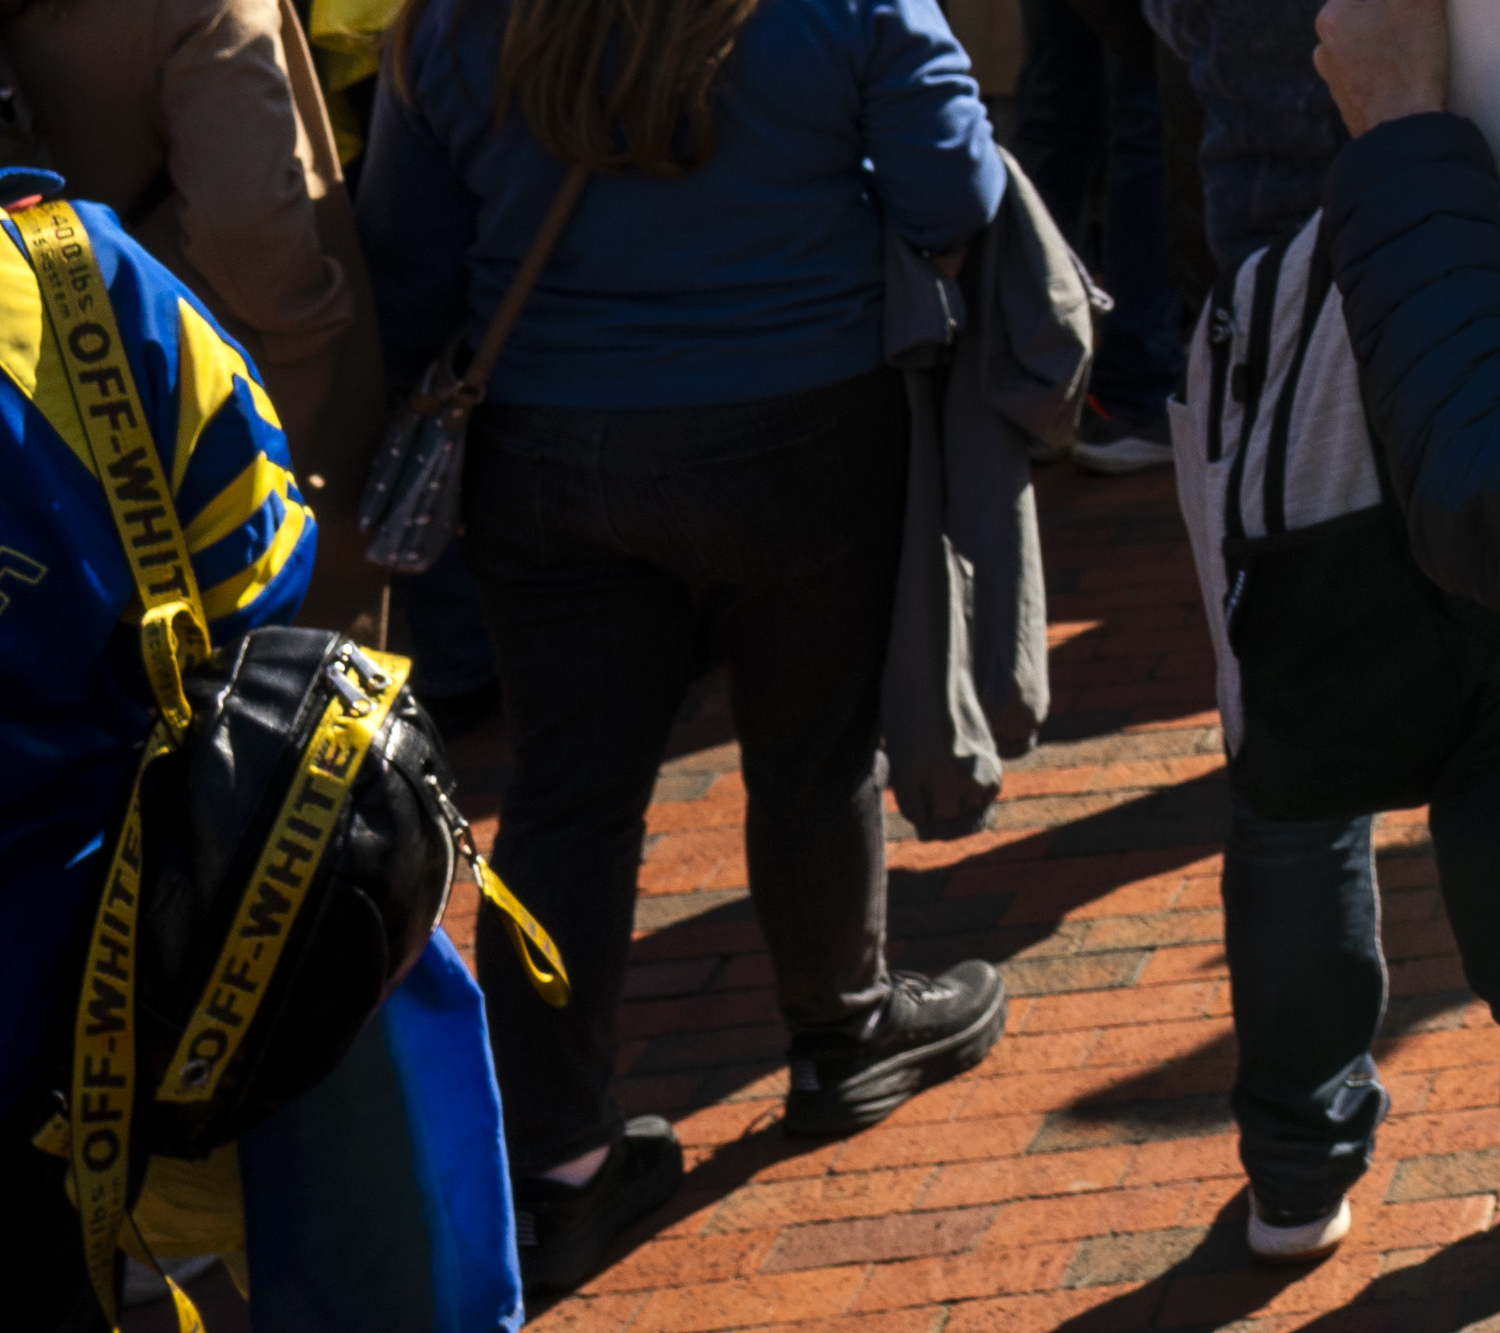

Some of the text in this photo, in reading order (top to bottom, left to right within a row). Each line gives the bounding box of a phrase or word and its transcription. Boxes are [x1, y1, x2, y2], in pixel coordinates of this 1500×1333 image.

[68, 321, 193, 603] OFF-WHIT
[80, 838, 142, 1175] OFF-WHITE
[186, 743, 358, 1075] OFF-WHITE
